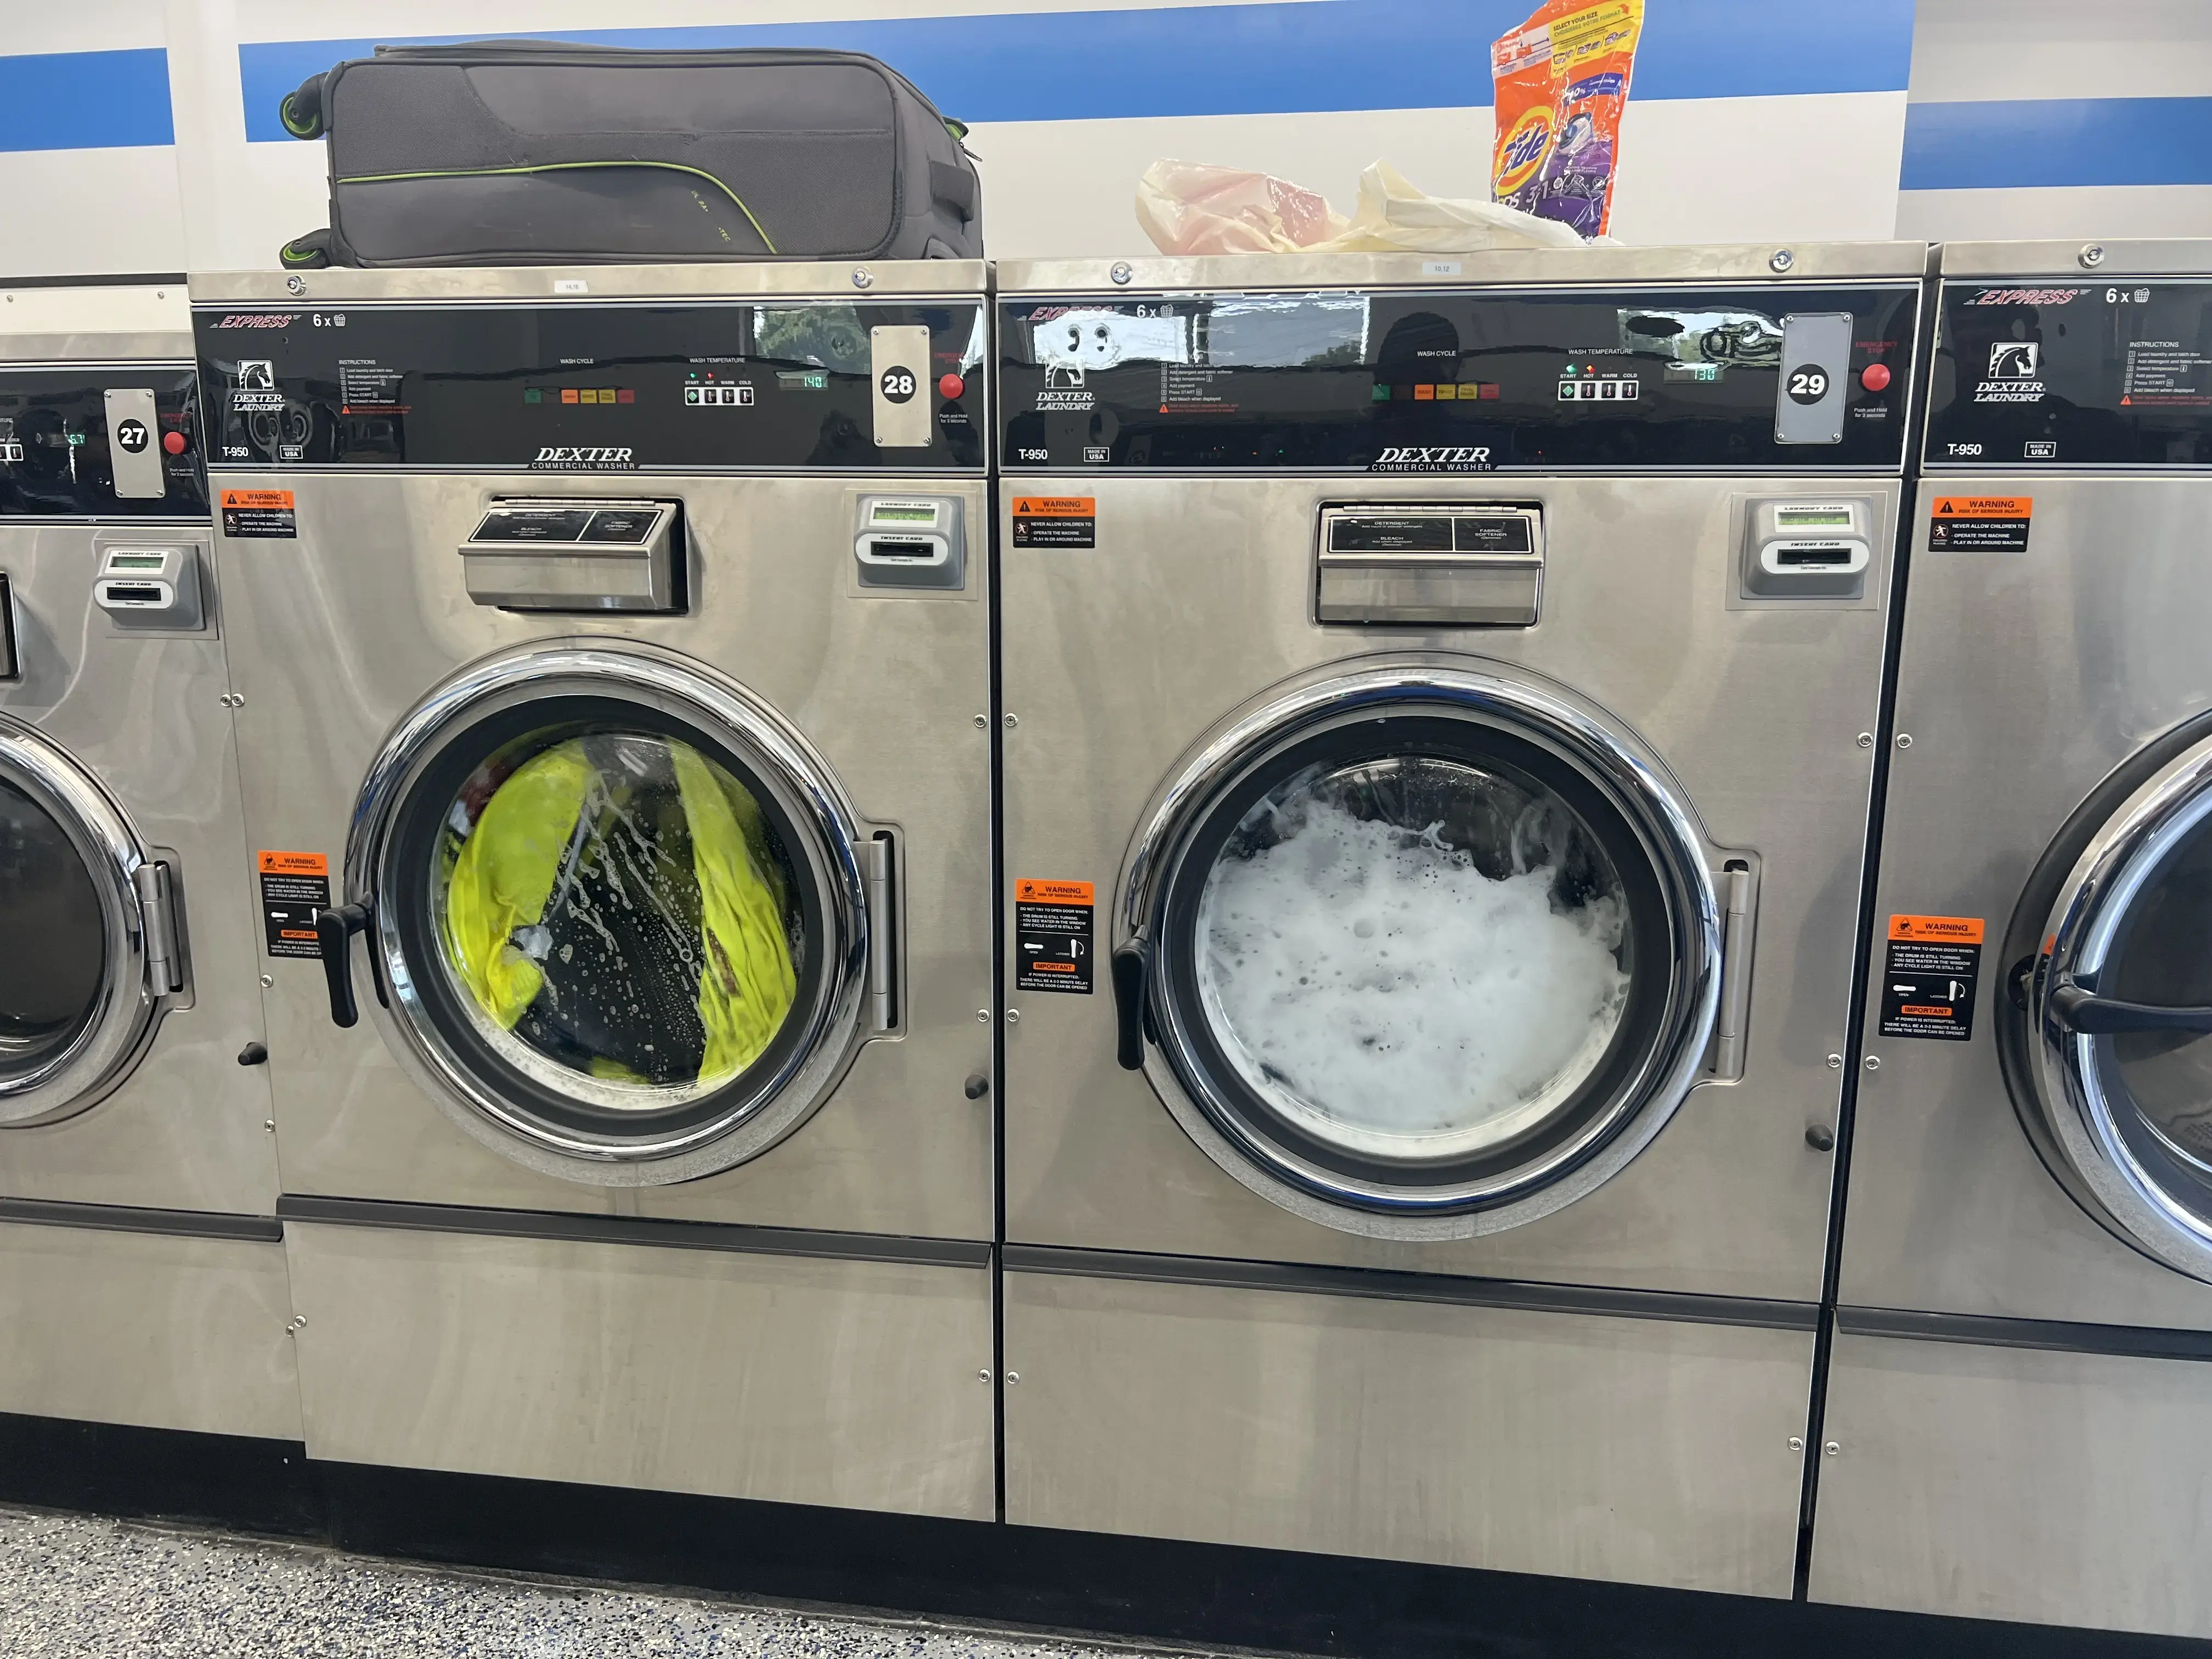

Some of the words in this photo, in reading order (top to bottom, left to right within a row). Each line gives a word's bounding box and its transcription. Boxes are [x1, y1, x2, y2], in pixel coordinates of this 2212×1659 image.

[1600, 10, 1621, 21] FORMAT
[1554, 21, 1570, 31] SELECT
[1571, 16, 1585, 24] YOUR
[1504, 123, 1549, 175] Tide
[1977, 289, 2078, 305] EXPRESS
[2106, 288, 2117, 303] 6
[2120, 293, 2130, 303] x
[1137, 304, 1146, 318] 6
[1150, 309, 1156, 318] x
[219, 315, 292, 328] EXPRESS
[313, 314, 321, 326] 6
[324, 318, 331, 326] x
[1695, 369, 1714, 380] 130
[804, 377, 822, 387] 140
[884, 375, 912, 394] 28
[1791, 375, 1824, 394] 29
[1975, 382, 2043, 392] DEXTER
[233, 394, 283, 402] DEXTER
[1036, 392, 1093, 401] DEXTER
[1973, 393, 2044, 402] LAUNDRY
[120, 427, 145, 444] 27
[222, 447, 249, 456] T-950
[534, 447, 632, 461] DEXTER
[1018, 449, 1048, 460] T-950
[1376, 447, 1489, 462] DEXTER
[1948, 444, 1982, 455] T-950
